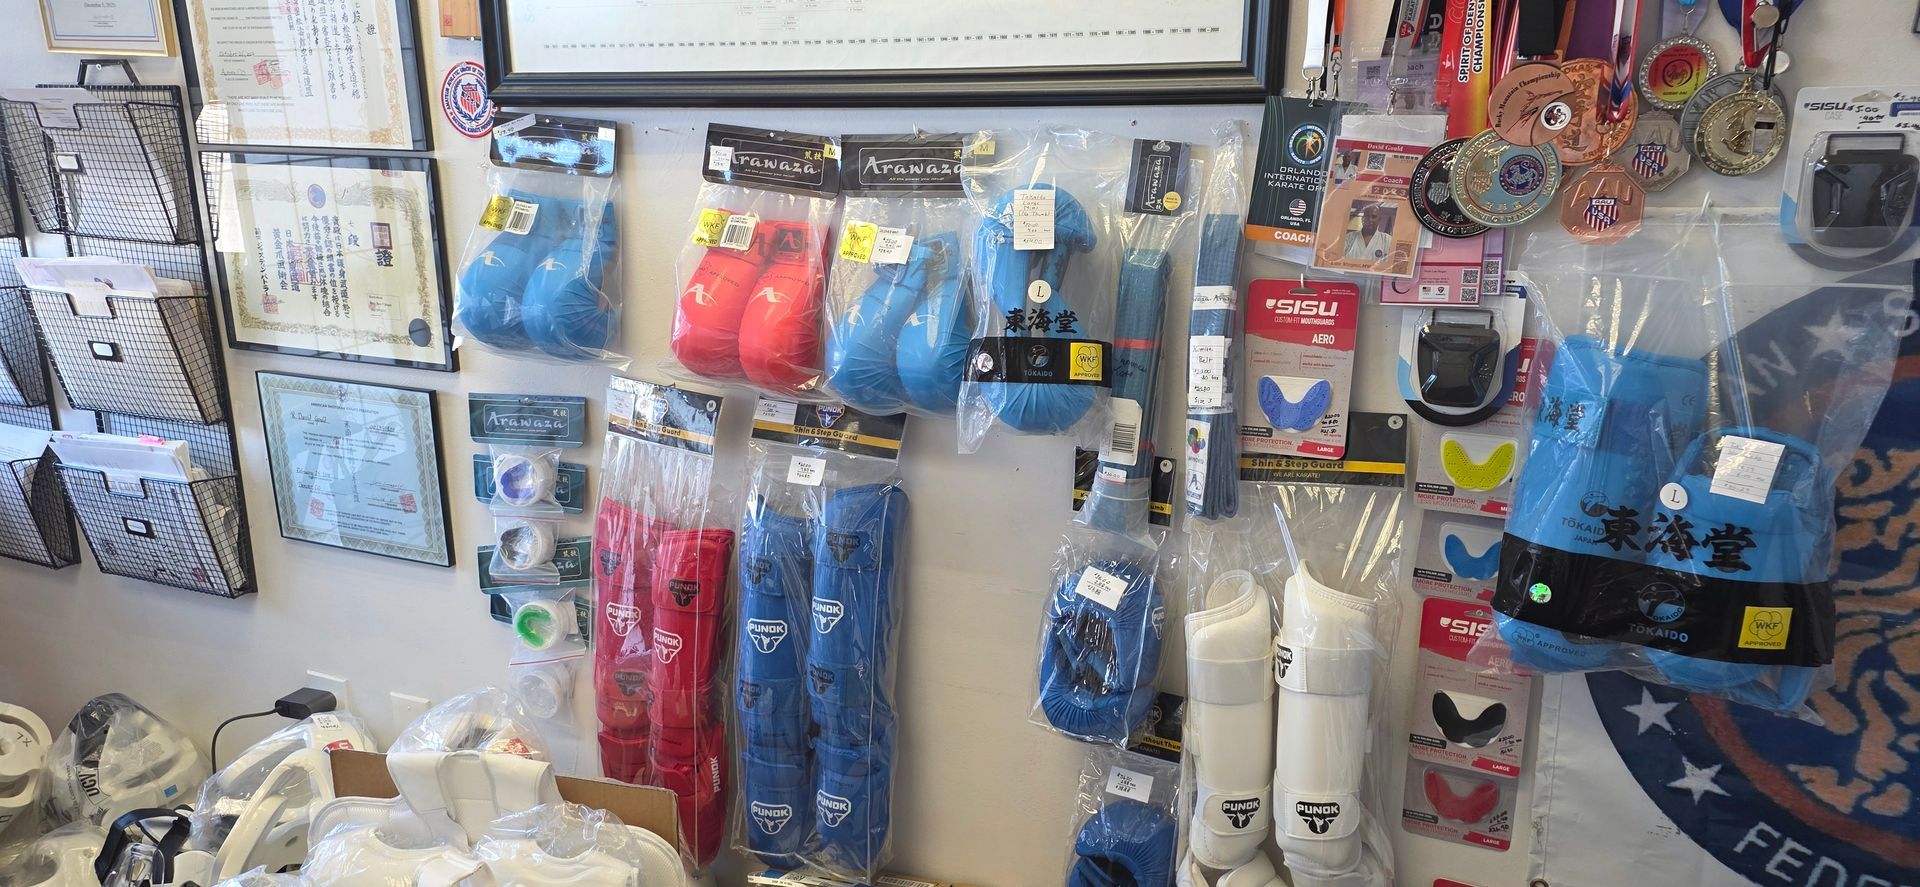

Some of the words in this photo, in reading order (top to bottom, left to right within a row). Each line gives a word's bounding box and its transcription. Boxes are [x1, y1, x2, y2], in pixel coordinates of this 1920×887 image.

[1463, 30, 1472, 45] OF
[1474, 0, 1486, 72] CHAMPIONS
[1459, 49, 1471, 82] SPIRIT
[1808, 102, 1847, 111] SISU
[828, 147, 836, 156] M
[980, 143, 989, 152] M
[1367, 143, 1385, 151] David
[863, 156, 963, 176] Arawaza
[1640, 154, 1659, 171] USA
[1280, 166, 1328, 178] ORLANDO
[1145, 158, 1162, 209] Arawaza
[1268, 180, 1305, 191] KARATE
[1591, 206, 1611, 225] USA
[703, 221, 720, 229] WKF
[850, 232, 868, 242] WKF
[1274, 230, 1314, 243] COACH
[375, 249, 393, 267] 證
[1037, 285, 1044, 298] L
[1003, 307, 1080, 334] 東海堂
[1301, 317, 1335, 326] MOUTHGUARDS
[1312, 334, 1335, 344] AERO
[1079, 355, 1098, 364] WKF
[818, 405, 843, 413] PUNOK
[1537, 396, 1586, 433] 海堂
[487, 411, 567, 429] Arawaza
[661, 426, 681, 437] Guard
[794, 425, 810, 433] Shin
[816, 428, 832, 437] Step
[833, 431, 858, 441] Guard
[1252, 459, 1274, 468] Shin
[1285, 460, 1307, 470] Step
[1309, 461, 1344, 469] Guard
[1436, 495, 1476, 505] PROTECTION.
[1670, 489, 1680, 504] L
[1561, 516, 1606, 536] TŌKAID
[828, 535, 860, 546] PUNOK
[1600, 505, 1757, 571] 東海堂
[669, 581, 700, 591] PUNOK
[608, 607, 639, 620] PUNOK
[812, 601, 841, 614] PUNOK
[1653, 607, 1684, 622] OKAIDO
[749, 622, 784, 633] PUNOK
[1755, 621, 1780, 631] WKF
[654, 632, 680, 647] PUNOK
[1743, 639, 1782, 648] APPROVED
[1536, 640, 1586, 658] APPROVED
[1492, 763, 1511, 772] LARGE
[711, 756, 721, 793] PUNOK
[816, 794, 848, 811] PUNOK
[1222, 799, 1260, 811] PUNOK
[752, 807, 789, 817] PUNOK
[1296, 804, 1339, 815] PUNOK
[1483, 837, 1500, 846] LARGE
